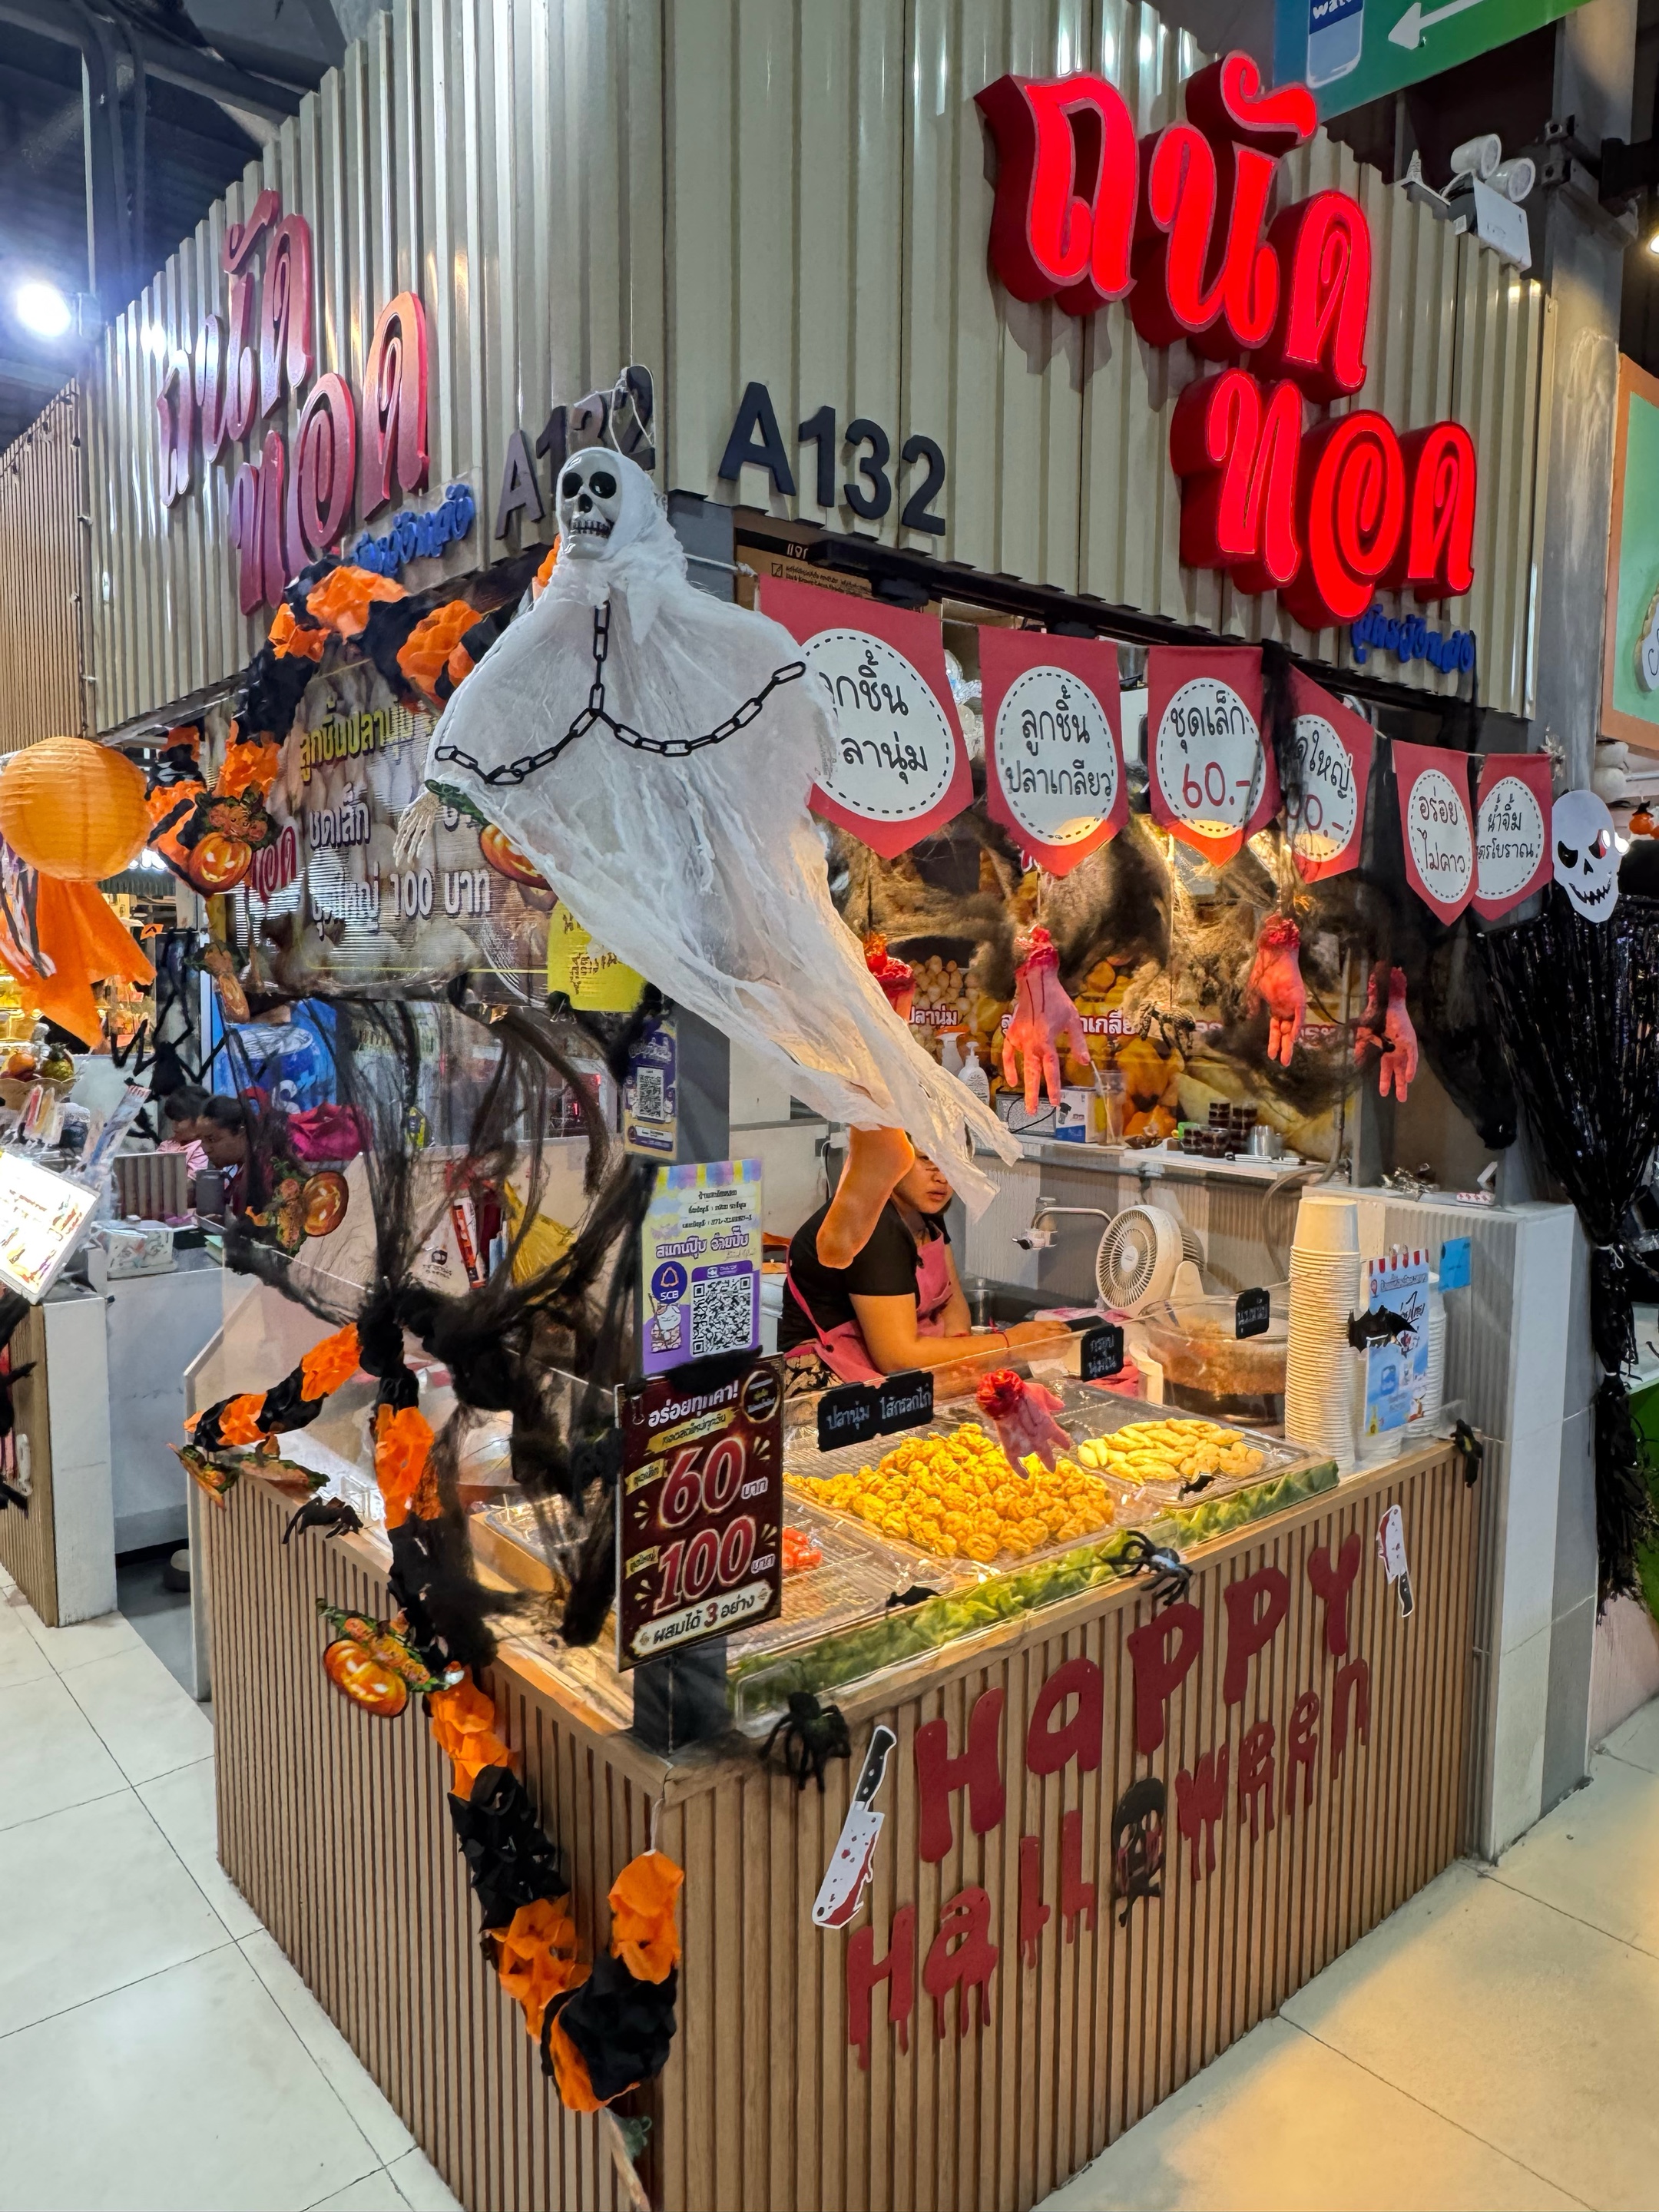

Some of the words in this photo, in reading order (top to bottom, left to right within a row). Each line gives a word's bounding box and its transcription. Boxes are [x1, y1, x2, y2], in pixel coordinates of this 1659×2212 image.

[1002, 49, 1373, 399] ถนัด
[231, 292, 430, 616] ทอด
[718, 382, 946, 536] A132
[1183, 367, 1477, 621] ทอด
[1021, 684, 1091, 757] ลูกชิ้น
[1170, 689, 1247, 754] ชุดเล็ก
[840, 730, 929, 785] ลานุ่ม
[1005, 759, 1114, 798] ปลาเกลียว
[1181, 760, 1252, 809] 60.-
[1419, 786, 1459, 826] อร่อย
[1416, 826, 1467, 873] ไม่คาว
[389, 869, 434, 922] 100
[442, 869, 492, 916] บาท
[660, 1290, 680, 1301] SCB
[659, 1435, 747, 1528] 60
[653, 1513, 757, 1617] 100
[653, 1608, 703, 1645] ผสมได้
[703, 1601, 719, 1628] 3
[720, 1593, 756, 1619] อย่าง
